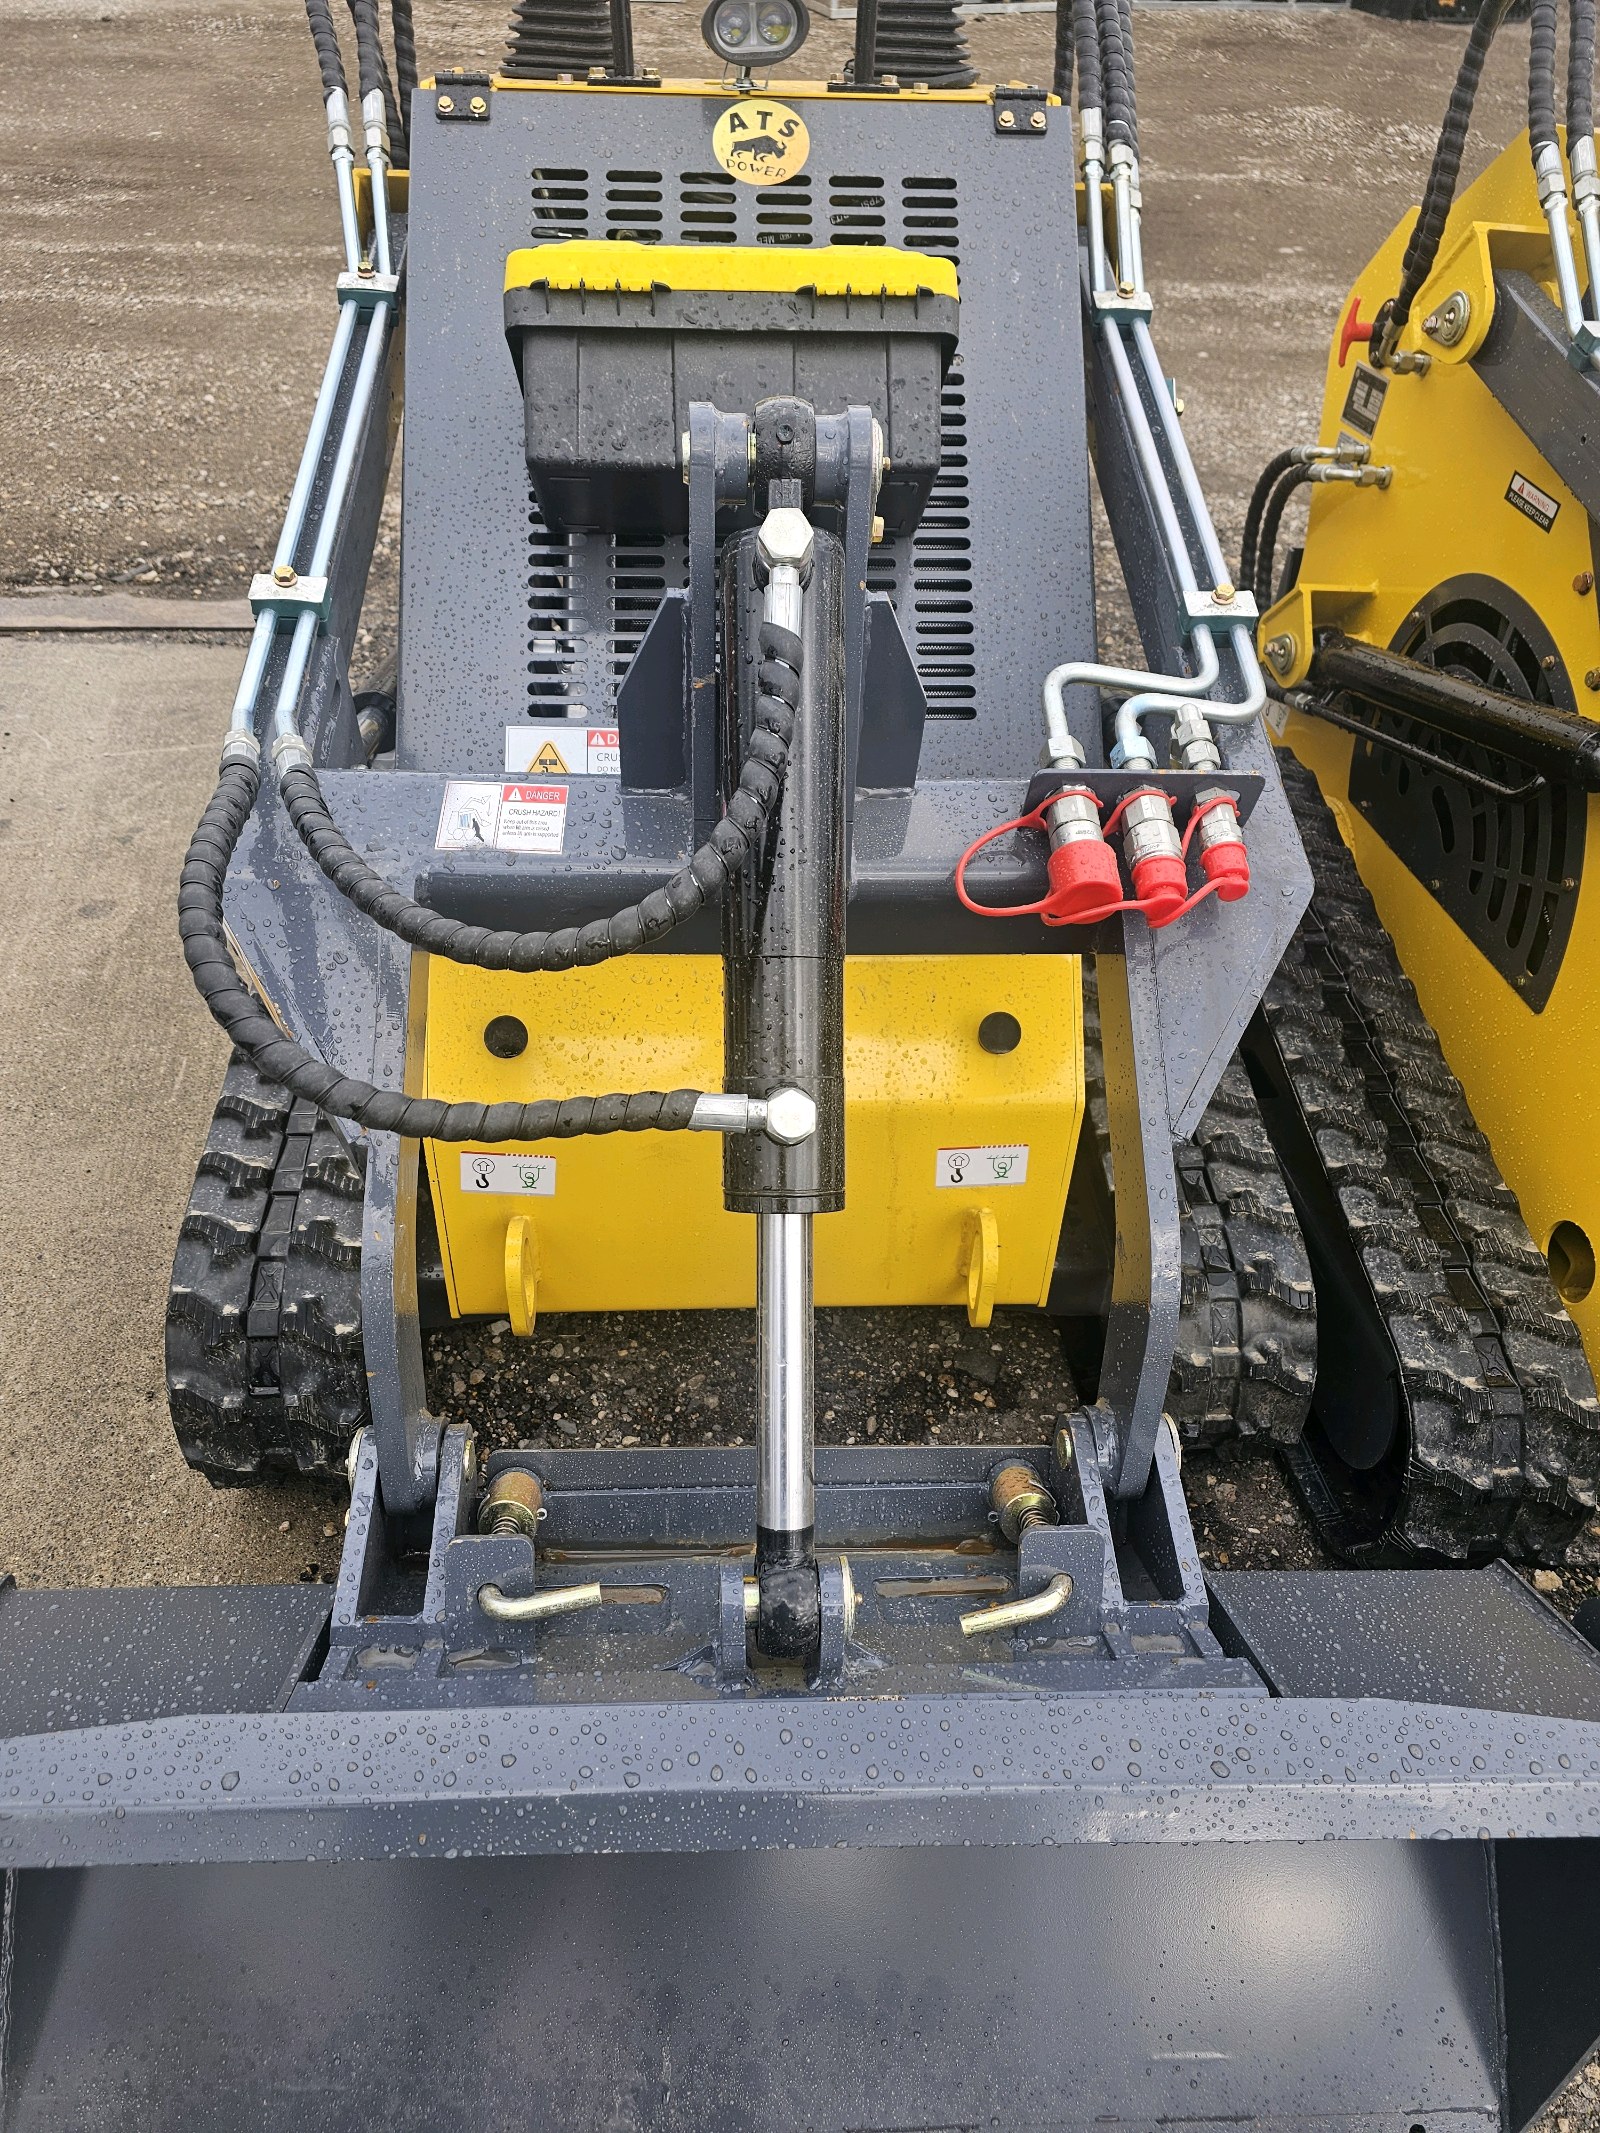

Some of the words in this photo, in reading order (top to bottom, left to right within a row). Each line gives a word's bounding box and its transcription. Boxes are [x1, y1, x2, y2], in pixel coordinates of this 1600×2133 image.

[729, 110, 800, 137] ATS
[726, 158, 787, 178] POWER
[1526, 490, 1550, 512] WARNING
[1508, 492, 1524, 509] PLEASE
[1524, 502, 1535, 515] KEEP
[1534, 510, 1550, 527] CLEAR
[597, 752, 621, 762] CRU
[597, 765, 609, 773] DO
[525, 790, 561, 801] DANGER
[508, 808, 532, 816] CRUSH
